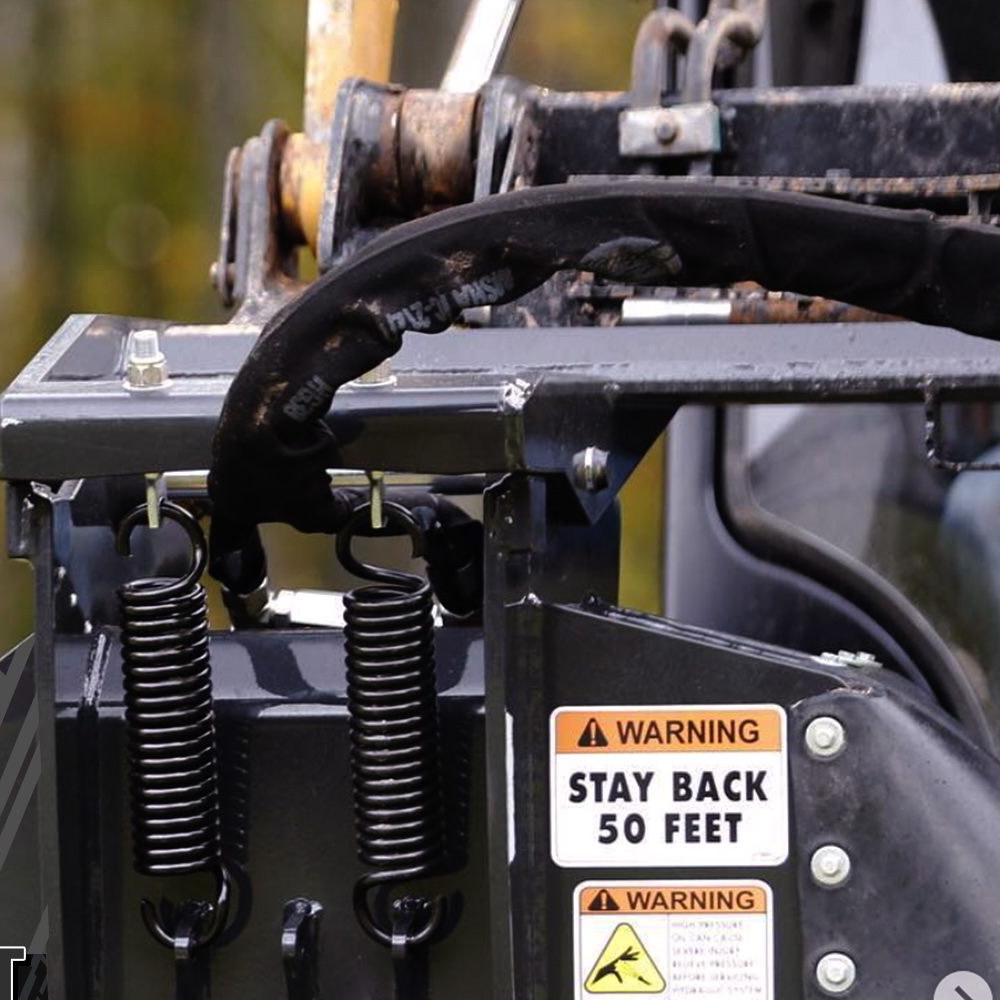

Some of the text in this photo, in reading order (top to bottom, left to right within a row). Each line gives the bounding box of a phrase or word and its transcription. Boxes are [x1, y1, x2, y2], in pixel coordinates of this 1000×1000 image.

[616, 719, 760, 745] WARNING
[568, 770, 768, 803] STAY BACK
[598, 812, 743, 844] 50 FEET
[626, 890, 756, 911] WARNING
